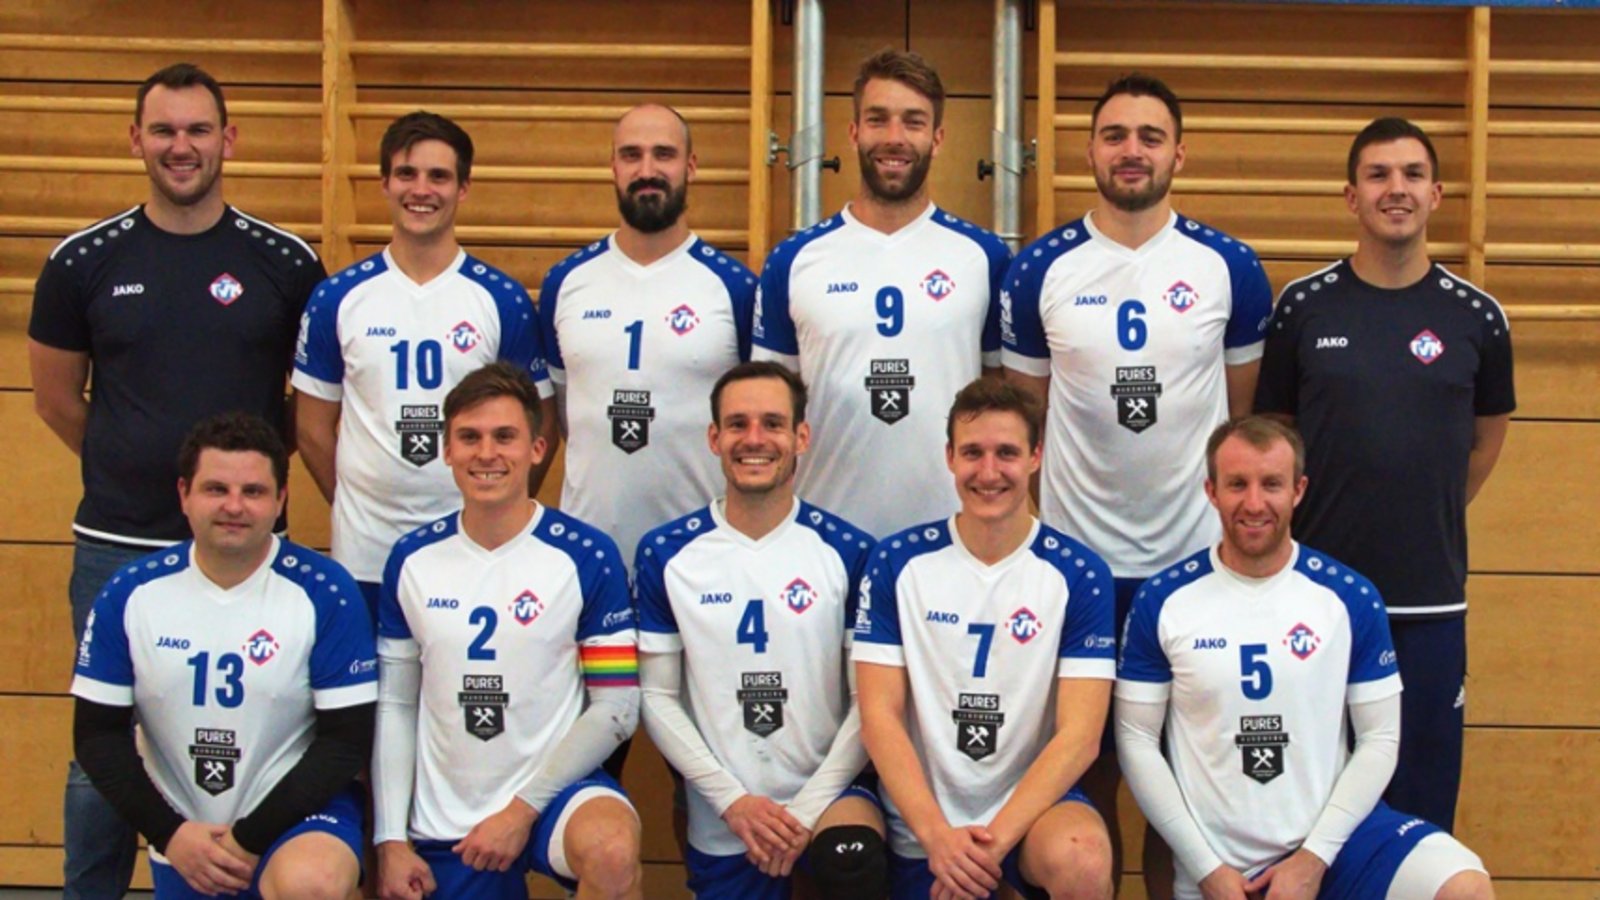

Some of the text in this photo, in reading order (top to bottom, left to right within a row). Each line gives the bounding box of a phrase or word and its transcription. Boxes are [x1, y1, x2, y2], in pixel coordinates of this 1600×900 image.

[112, 283, 144, 296] JAKO
[826, 281, 858, 294] JAKO
[1074, 295, 1107, 306] JAKO
[582, 309, 612, 320] JAKO
[875, 285, 904, 338] 9
[1117, 299, 1147, 351] 6
[366, 327, 396, 337] JAKO
[624, 320, 644, 370] 1
[1315, 336, 1348, 349] JAKO
[390, 338, 443, 390] 10
[872, 361, 908, 373] PURES
[1118, 368, 1154, 381] PURES
[616, 391, 648, 405] PURES
[403, 407, 437, 418] PURES
[426, 597, 459, 609] JAKO
[700, 592, 733, 604] JAKO
[926, 611, 960, 625] JAKO
[467, 605, 498, 661] 2
[736, 599, 769, 654] 4
[156, 636, 191, 650] JAKO
[1193, 638, 1227, 650] JAKO
[967, 623, 996, 678] 7
[1239, 643, 1273, 701] 5
[187, 651, 245, 709] 13
[465, 676, 501, 689] PURES
[744, 674, 780, 686] PURES
[960, 695, 997, 709] PURES
[1242, 717, 1280, 730] PURES
[198, 730, 234, 745] PURES
